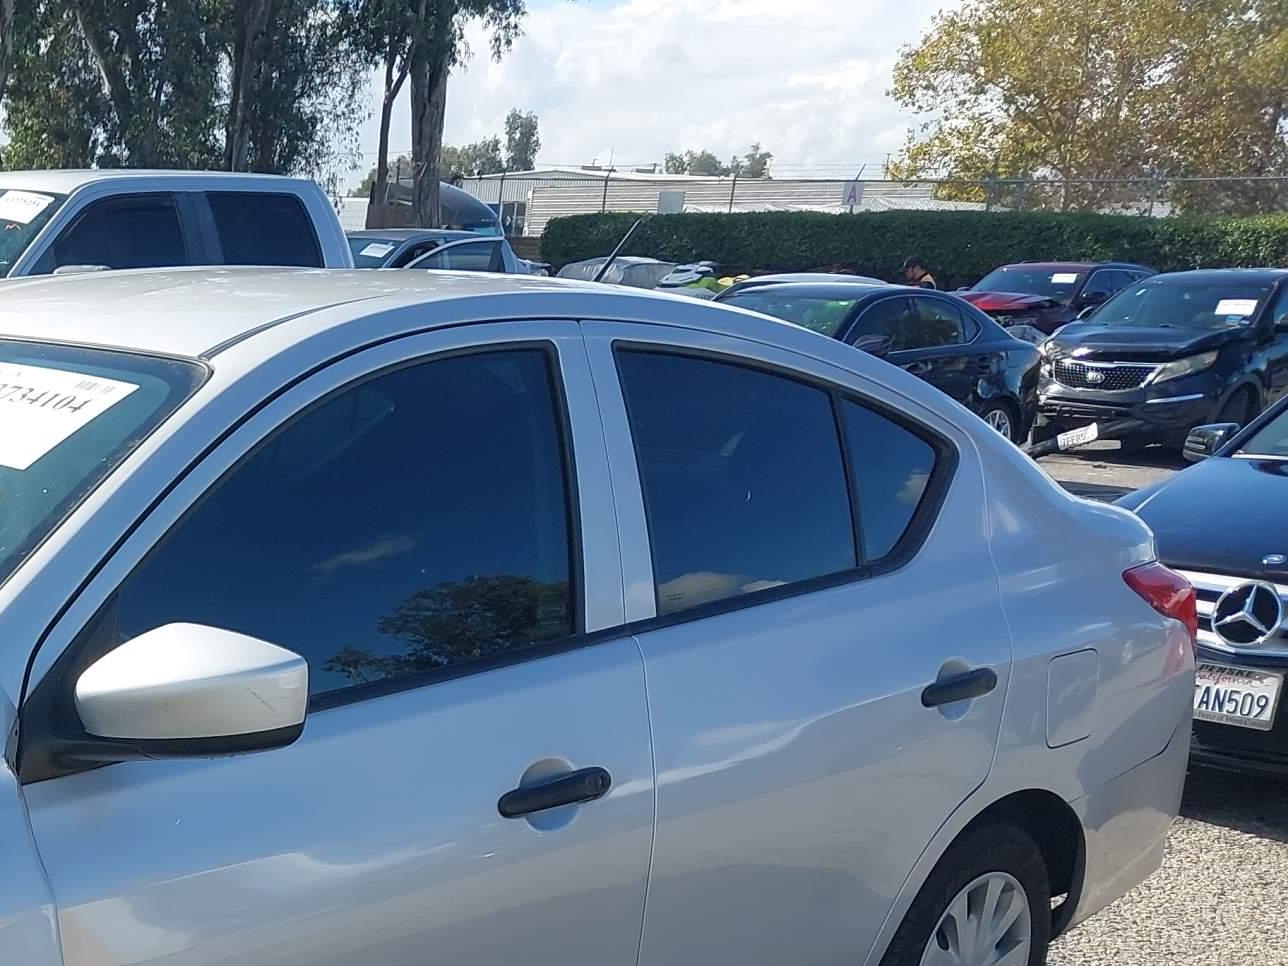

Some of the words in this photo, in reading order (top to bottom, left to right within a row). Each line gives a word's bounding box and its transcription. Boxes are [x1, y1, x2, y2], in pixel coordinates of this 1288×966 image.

[847, 184, 857, 203] A
[1198, 663, 1254, 678] PENSKE
[1196, 685, 1269, 718] AN509
